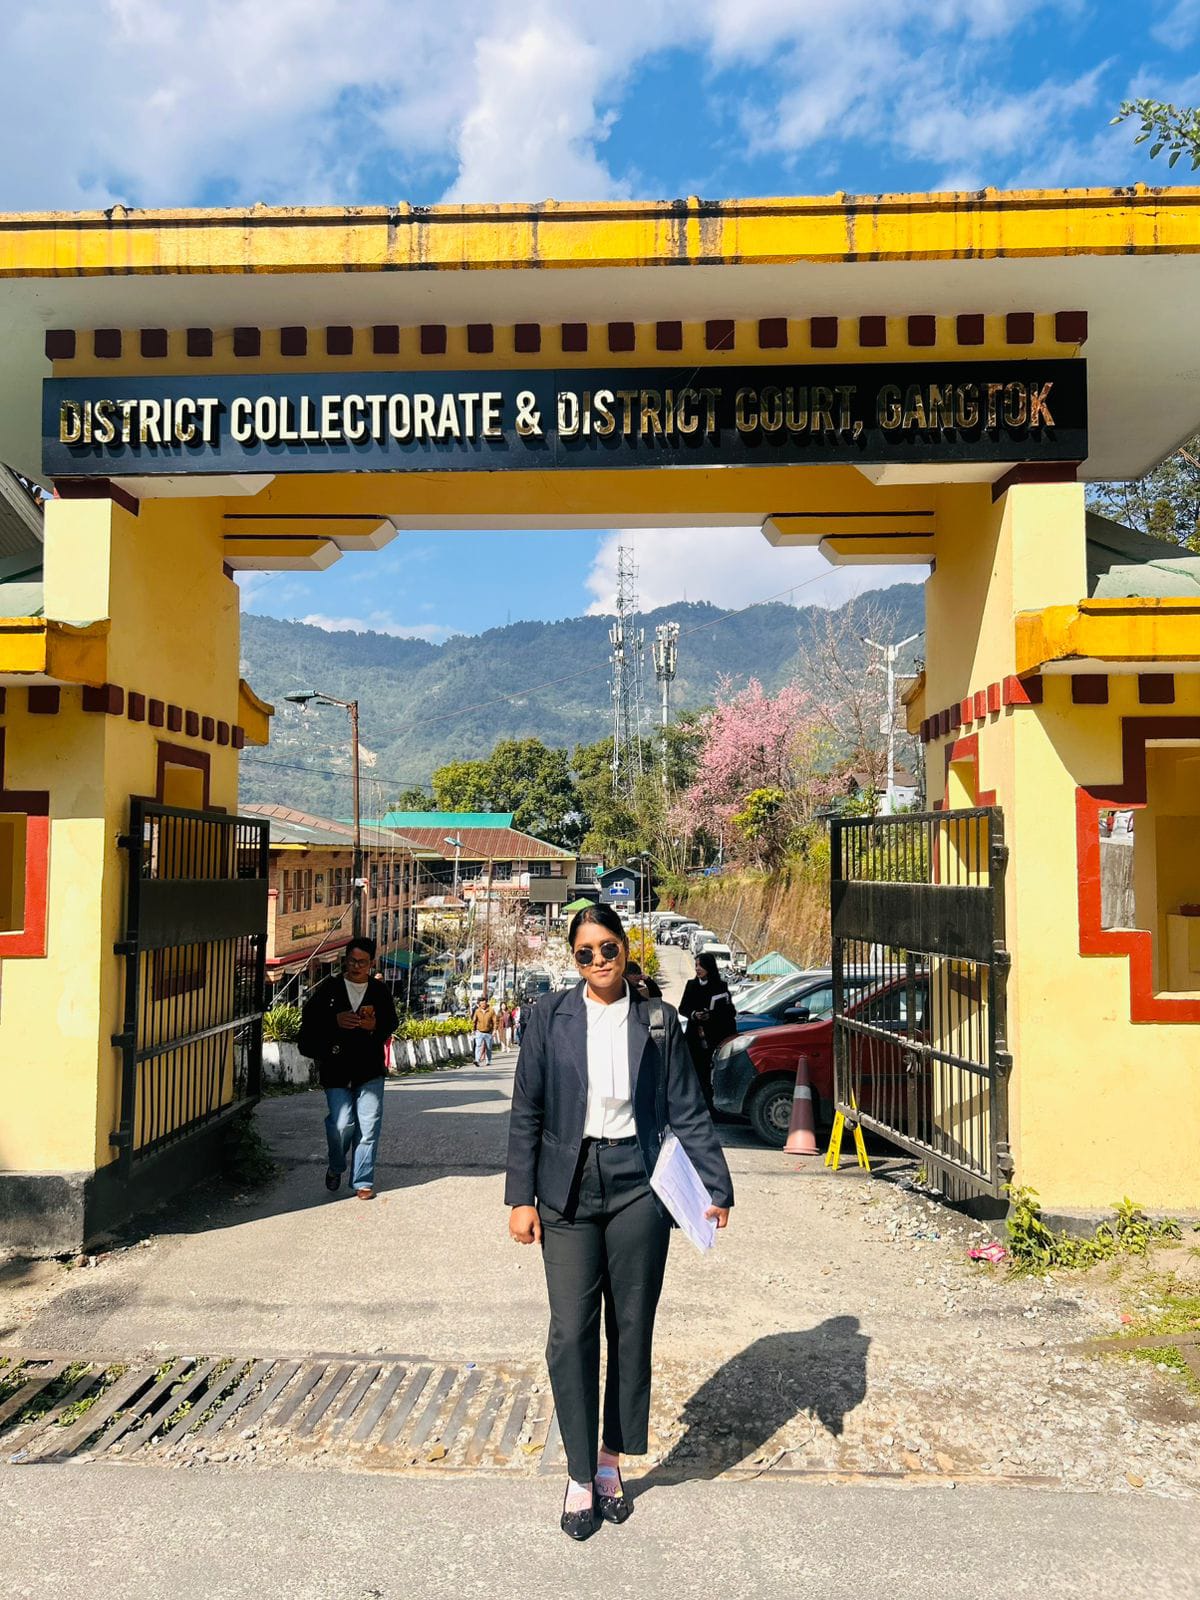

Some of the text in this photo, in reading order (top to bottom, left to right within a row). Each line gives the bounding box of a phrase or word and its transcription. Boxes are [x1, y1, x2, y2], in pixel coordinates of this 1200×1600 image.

[59, 382, 1056, 444] DISTRICT COLLECTORATE & DISTRICT COURT, GANGTOK
